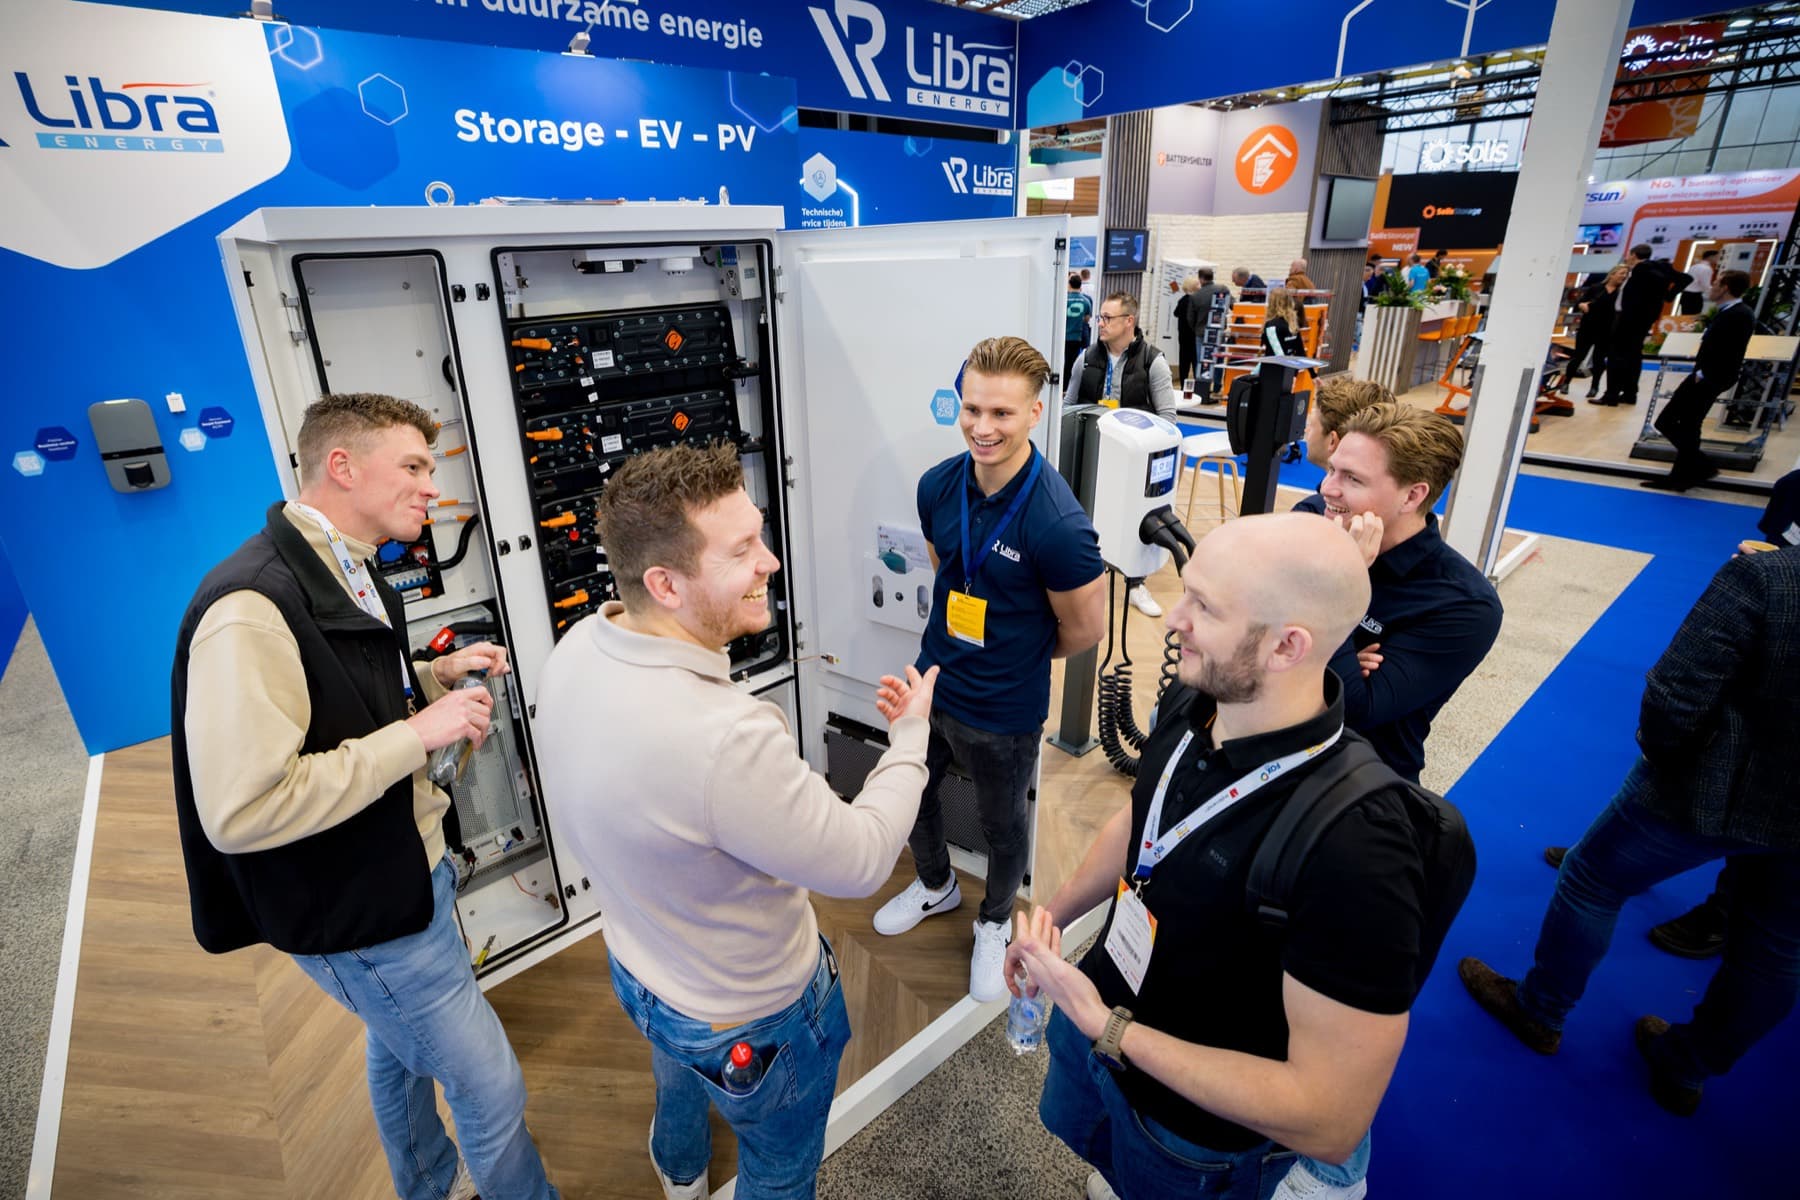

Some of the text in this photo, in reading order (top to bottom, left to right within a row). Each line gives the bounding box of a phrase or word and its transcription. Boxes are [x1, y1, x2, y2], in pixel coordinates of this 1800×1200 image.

[659, 12, 763, 50] energie
[906, 26, 1011, 98] Libra
[13, 71, 220, 134] Libra
[917, 93, 1001, 113] ENERGY
[54, 134, 209, 151] ENERGY
[454, 108, 605, 152] Storage
[638, 118, 682, 150] EV
[717, 123, 757, 152] PV
[1455, 139, 1509, 165] solis
[973, 164, 1013, 188] Libra
[1585, 191, 1620, 202] sun
